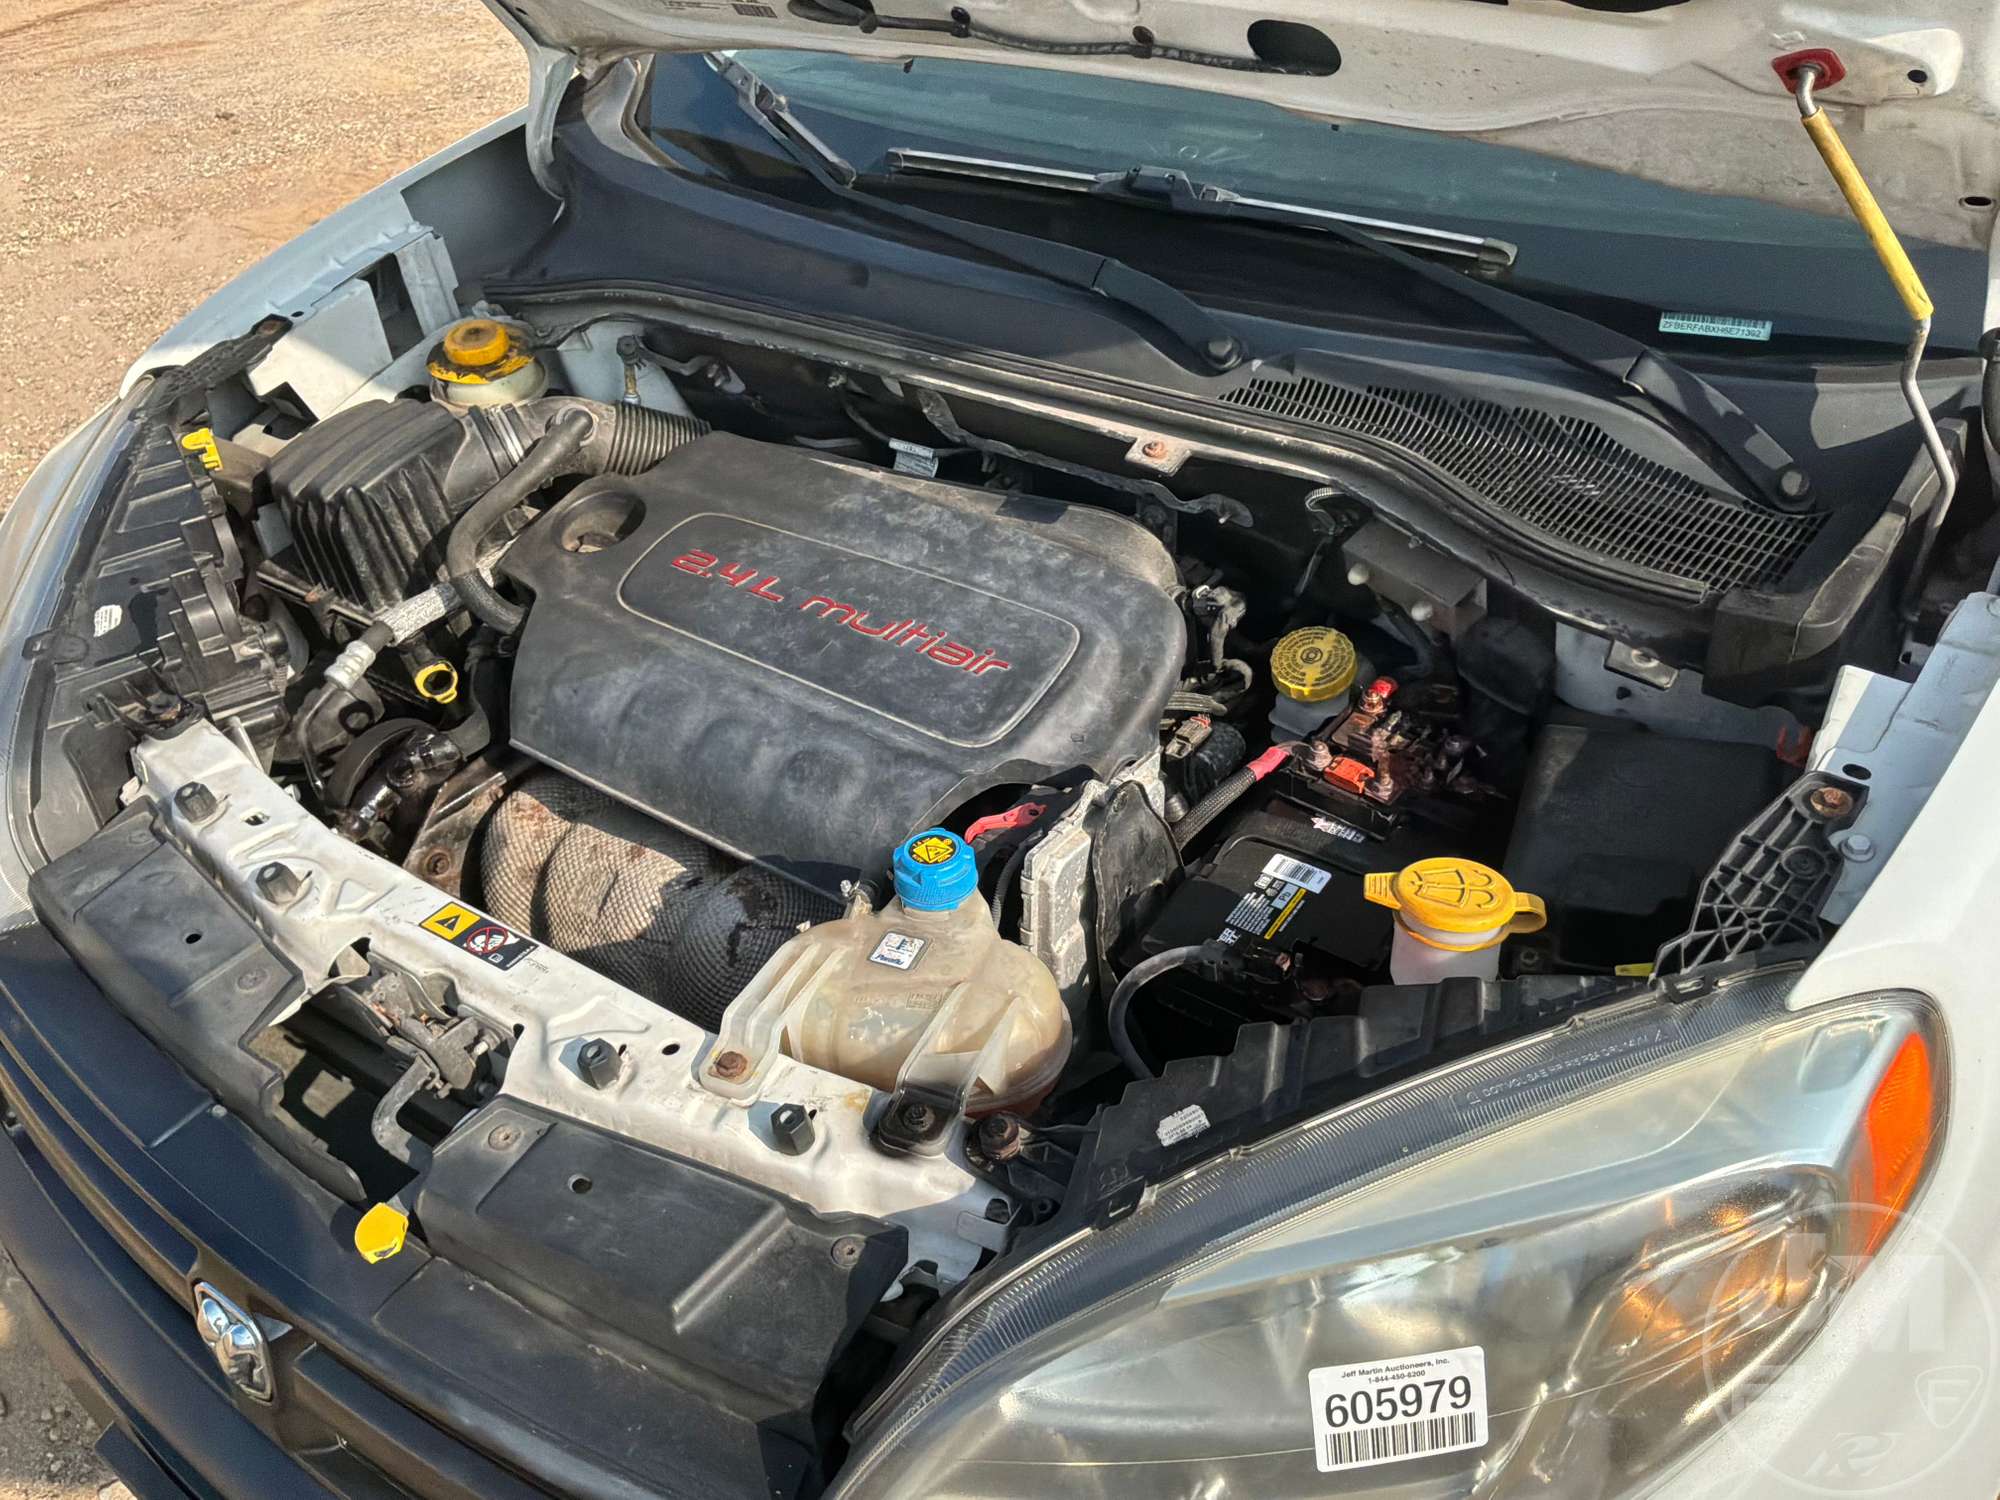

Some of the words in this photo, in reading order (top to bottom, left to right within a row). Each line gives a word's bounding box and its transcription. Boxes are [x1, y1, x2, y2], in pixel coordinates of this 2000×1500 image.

[799, 593, 1012, 677] multiair
[1341, 1369, 1357, 1380] Jeff
[1358, 1366, 1384, 1377] Martin
[1384, 1359, 1434, 1373] Auctioneers,
[1435, 1357, 1450, 1366] Inc.
[1325, 1375, 1472, 1428] 605979
